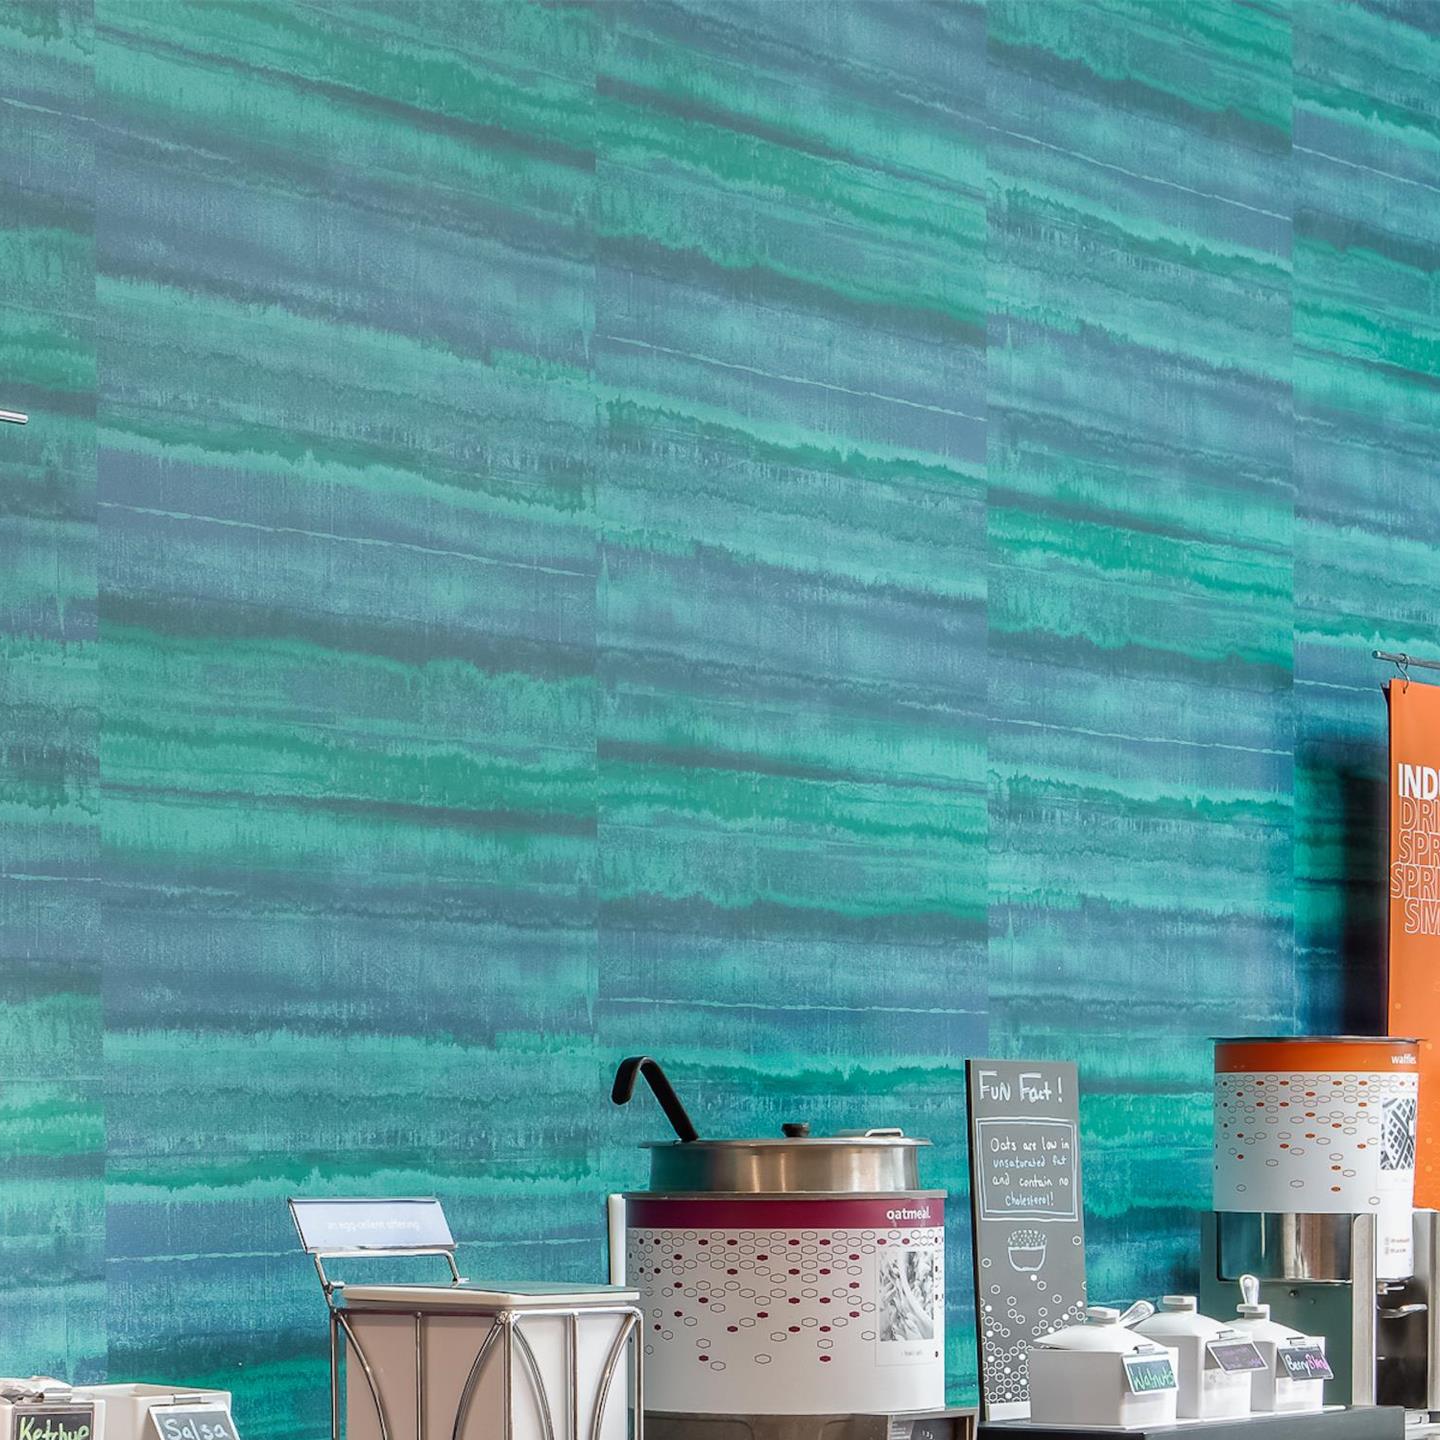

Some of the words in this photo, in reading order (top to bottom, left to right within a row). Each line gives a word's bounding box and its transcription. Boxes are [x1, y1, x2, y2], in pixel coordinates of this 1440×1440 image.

[990, 1136, 1017, 1152] Oats
[1023, 1142, 1037, 1151] are
[1041, 1136, 1057, 1151] low
[1060, 1137, 1070, 1149] in
[992, 1172, 1010, 1185] and
[1019, 1174, 1053, 1187] contain
[1059, 1177, 1069, 1186] no
